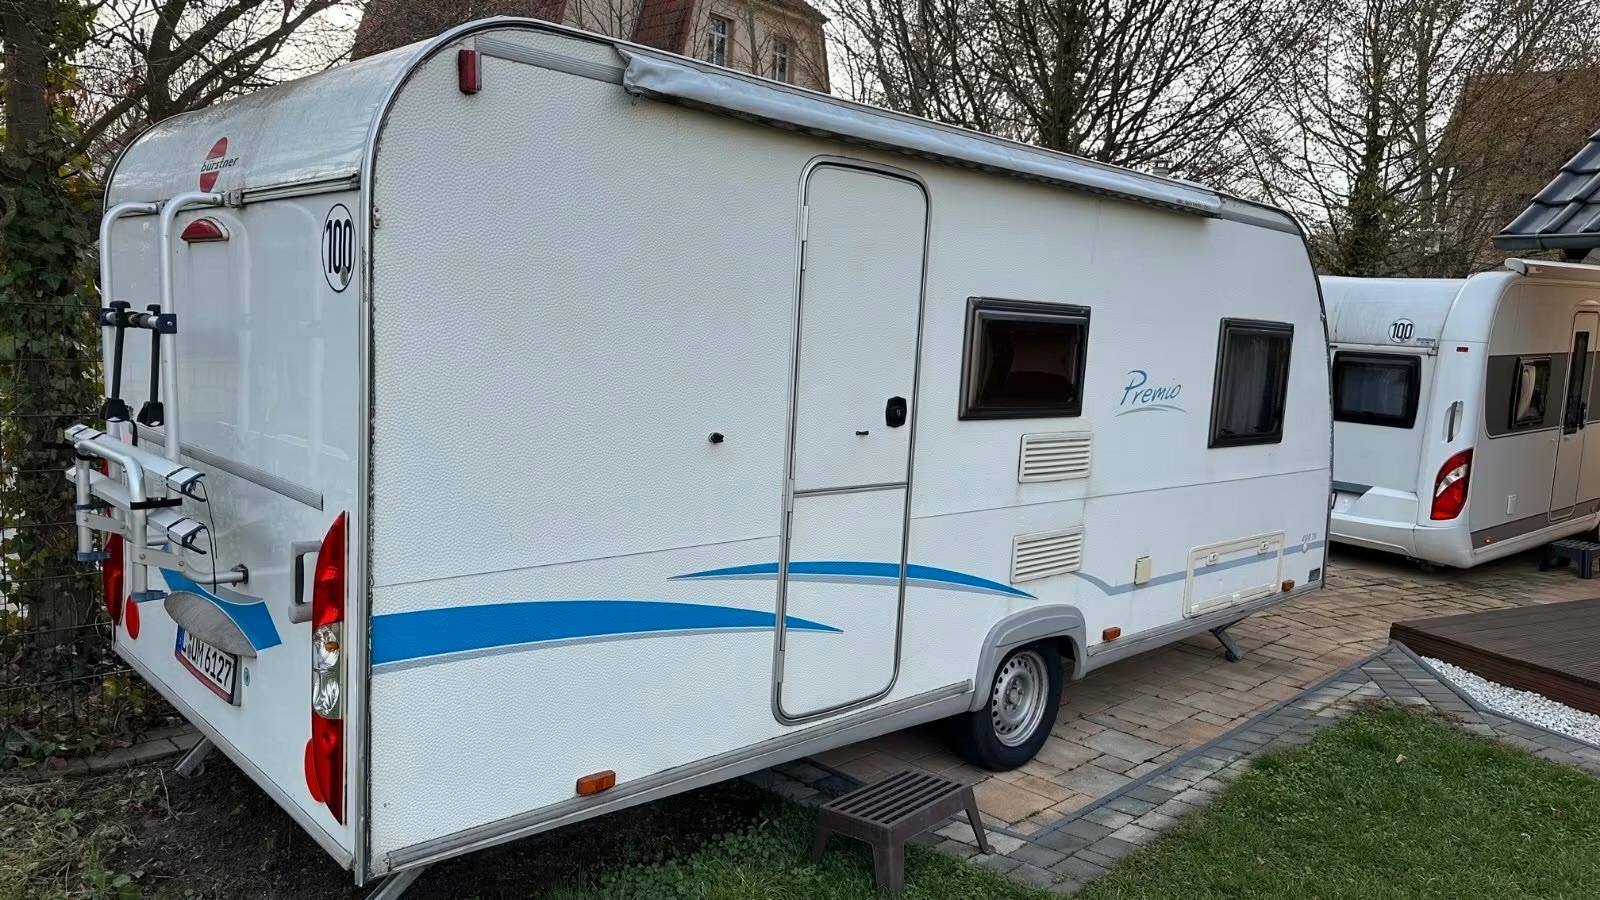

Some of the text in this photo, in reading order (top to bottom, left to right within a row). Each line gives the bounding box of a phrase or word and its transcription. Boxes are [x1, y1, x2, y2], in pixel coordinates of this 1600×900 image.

[201, 157, 239, 172] bürstner
[326, 218, 352, 274] 100
[1392, 322, 1413, 339] 100
[1120, 370, 1182, 406] Premio
[204, 647, 232, 687] 6127
